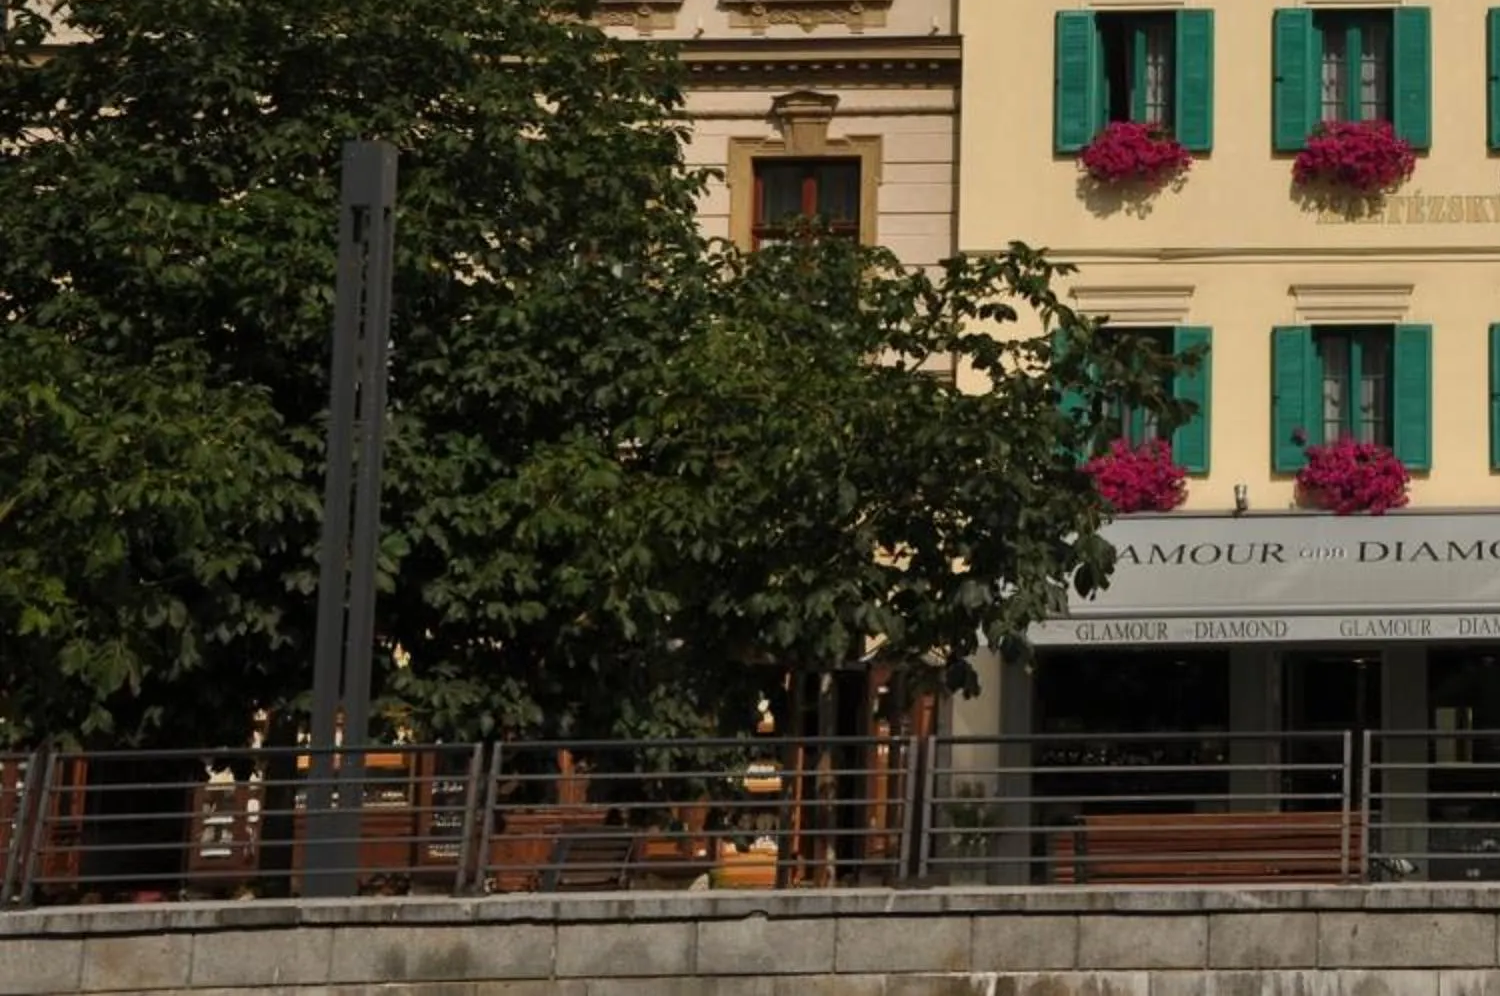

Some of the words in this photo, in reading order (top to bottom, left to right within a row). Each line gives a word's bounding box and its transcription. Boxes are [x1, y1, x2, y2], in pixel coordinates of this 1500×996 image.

[1115, 543, 1286, 565] AMOUR
[1075, 622, 1168, 642] GLAMOUR
[1193, 620, 1288, 640] DIAMOND
[1339, 618, 1431, 637] GLAMOUR
